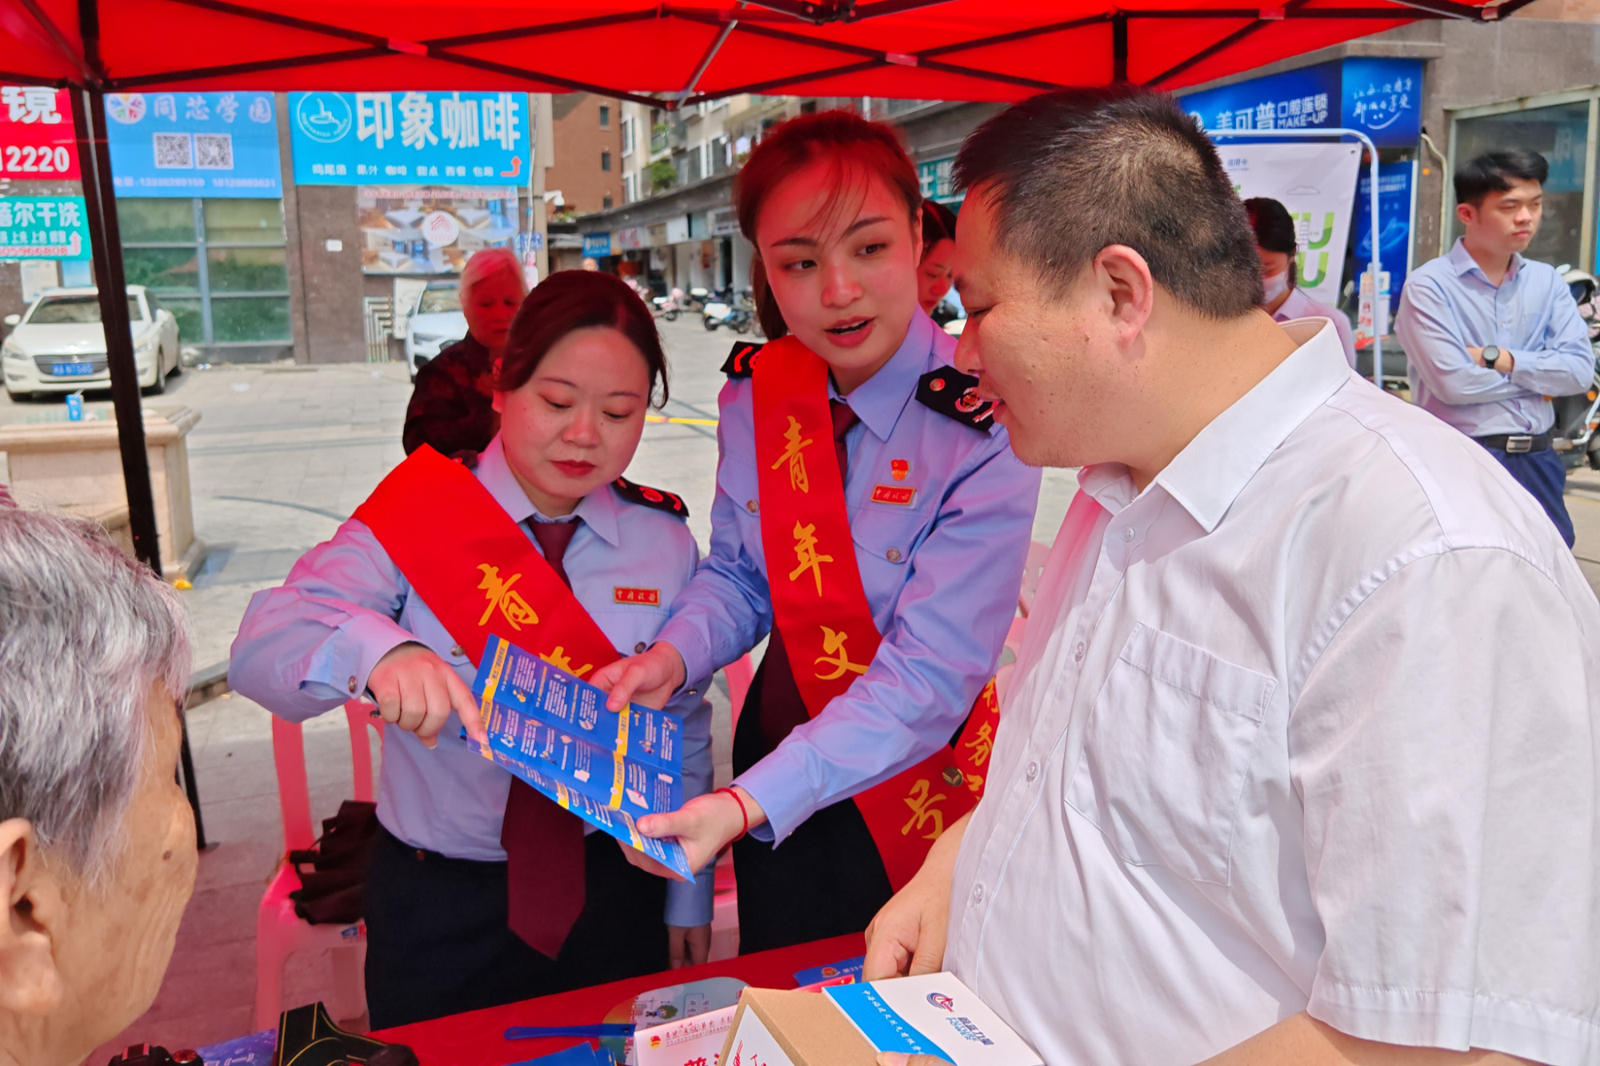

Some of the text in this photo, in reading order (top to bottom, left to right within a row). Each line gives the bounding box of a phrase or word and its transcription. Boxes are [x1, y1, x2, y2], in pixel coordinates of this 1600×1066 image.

[1, 86, 62, 124] 镜
[355, 92, 520, 150] 印象咖啡
[1215, 101, 1276, 141] 美可普
[1277, 110, 1329, 129] MAKE-UP
[0, 145, 70, 172] 2220
